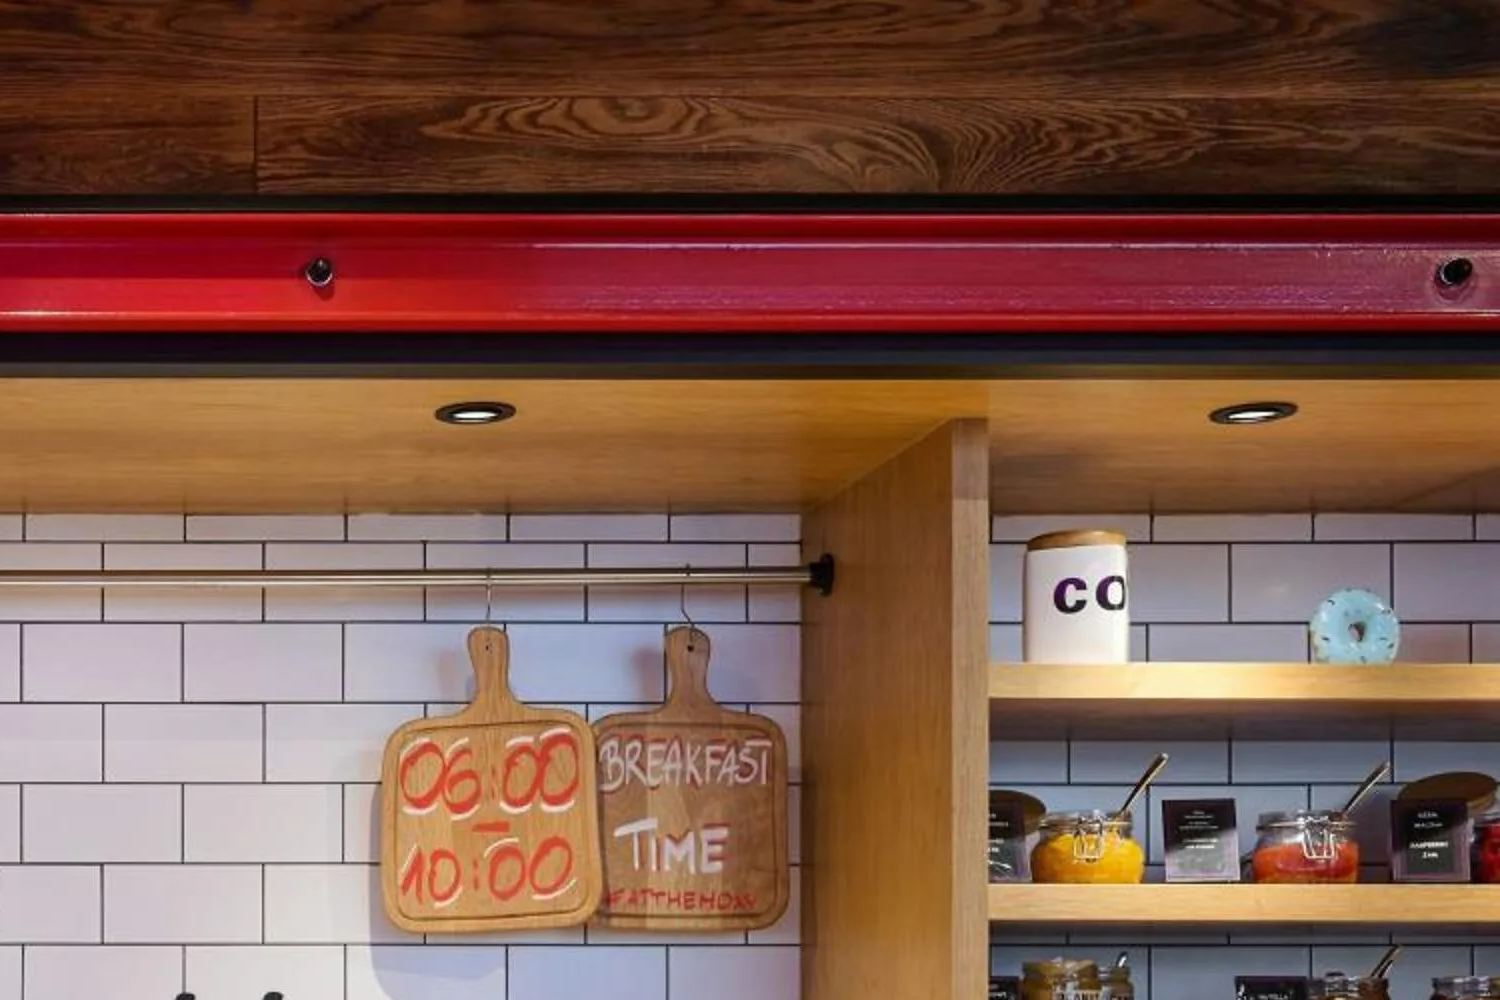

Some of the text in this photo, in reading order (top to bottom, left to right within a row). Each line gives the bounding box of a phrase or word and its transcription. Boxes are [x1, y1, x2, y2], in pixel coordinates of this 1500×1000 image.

[399, 728, 581, 820] 06:00
[599, 734, 772, 794] BREAKFAST
[400, 836, 578, 908] 10:00
[613, 816, 734, 876] TIME
